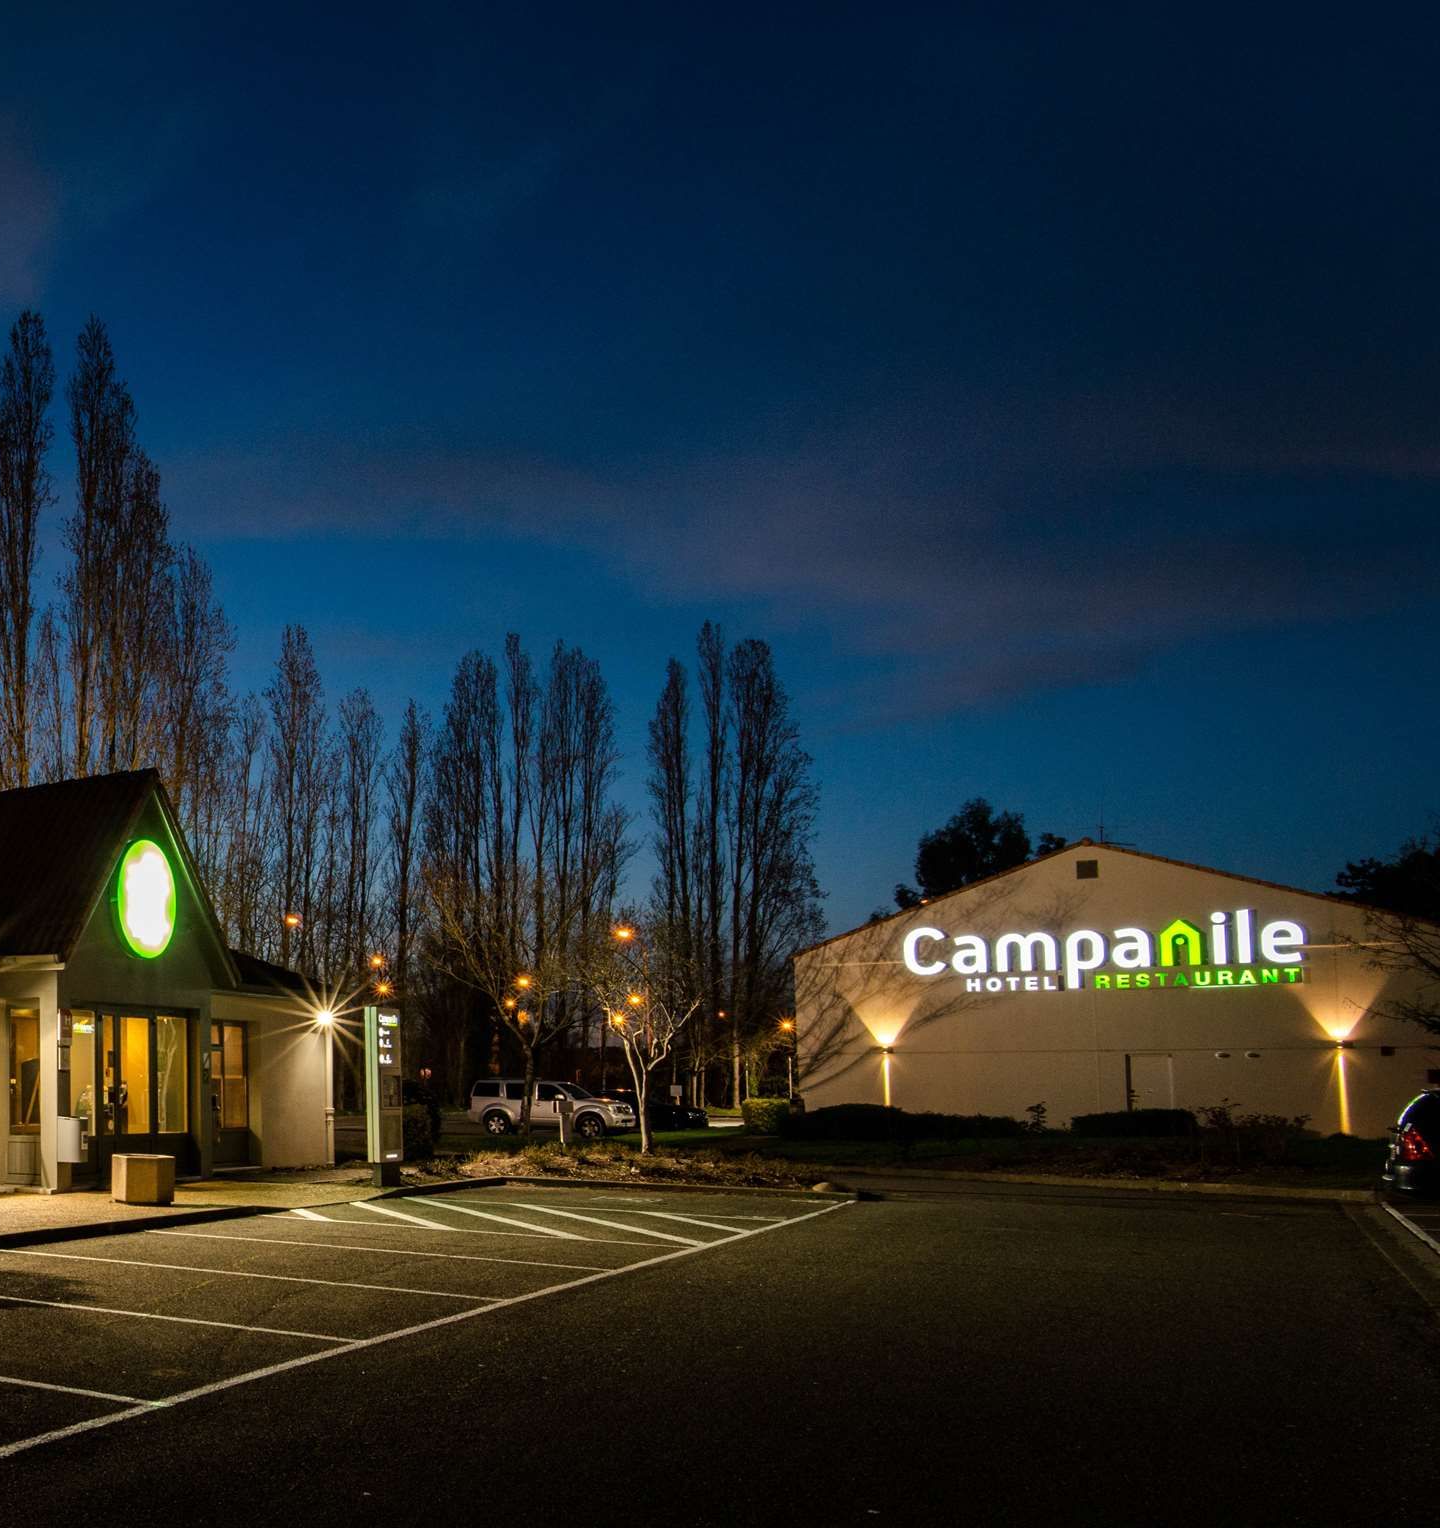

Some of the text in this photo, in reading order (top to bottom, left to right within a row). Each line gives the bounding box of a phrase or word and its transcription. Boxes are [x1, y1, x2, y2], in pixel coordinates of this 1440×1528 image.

[903, 909, 1305, 989] Campanile
[966, 968, 1300, 992] HOTEL RESTAURANT
